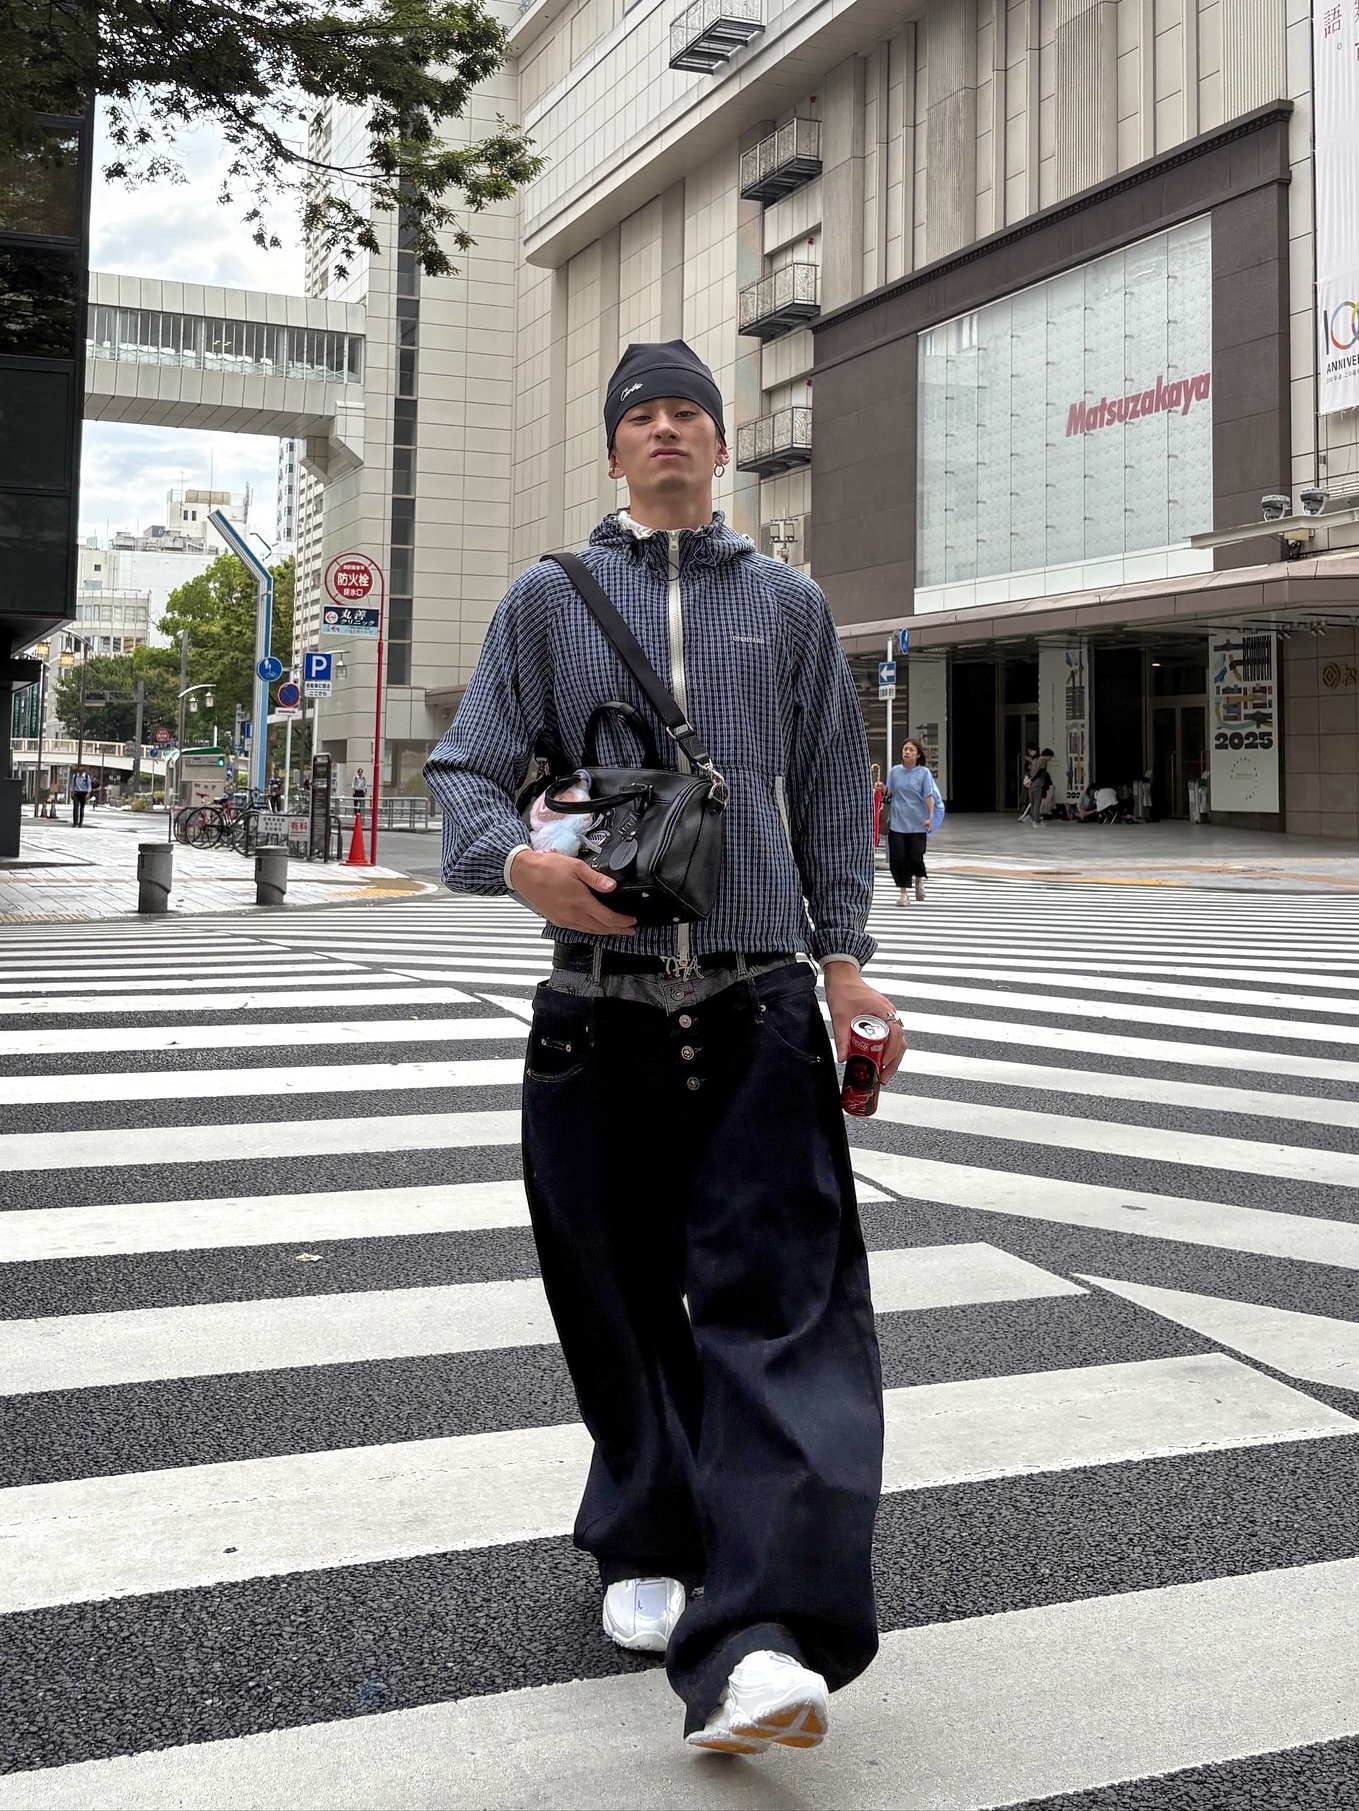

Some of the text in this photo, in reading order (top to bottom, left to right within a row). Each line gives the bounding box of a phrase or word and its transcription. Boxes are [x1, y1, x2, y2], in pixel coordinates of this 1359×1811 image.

[1326, 353, 1359, 375] ANNIVE
[1065, 372, 1211, 438] Matsuzakaya
[337, 572, 369, 587] 防火栓
[340, 618, 375, 626] クリニック
[311, 655, 328, 678] P
[1214, 731, 1273, 750] 2025
